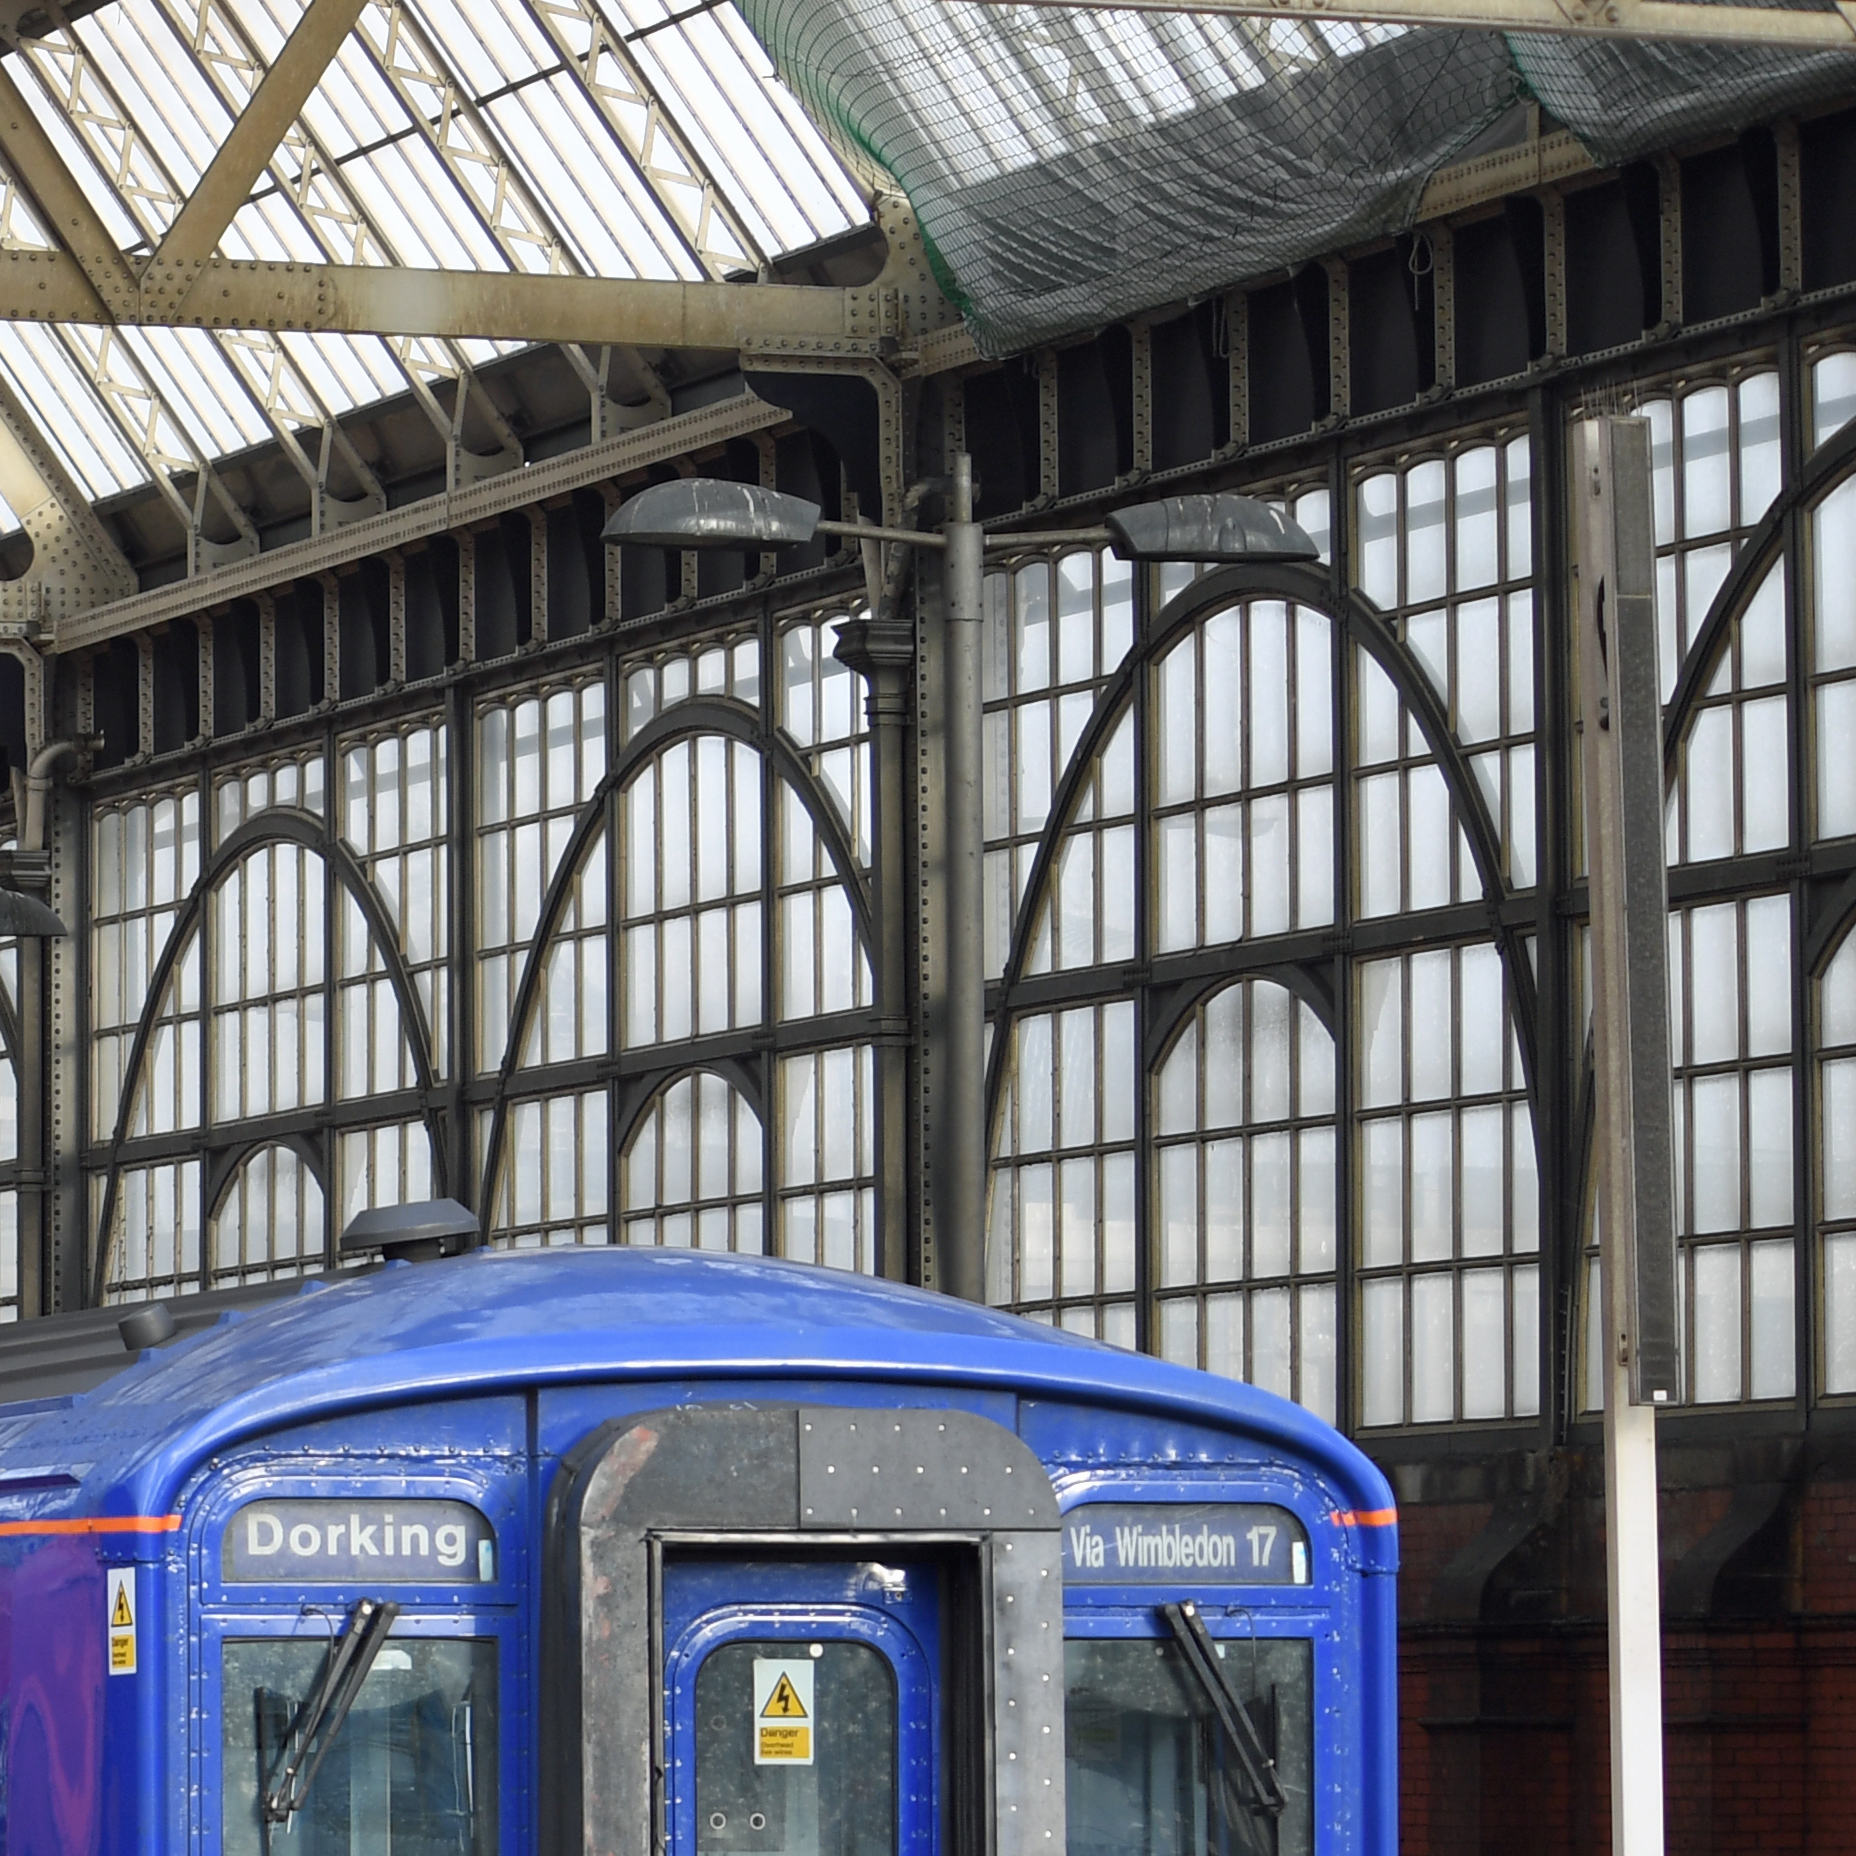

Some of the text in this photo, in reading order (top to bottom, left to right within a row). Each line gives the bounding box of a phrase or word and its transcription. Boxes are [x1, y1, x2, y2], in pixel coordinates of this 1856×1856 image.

[246, 1514, 467, 1567] Dorking
[1071, 1526, 1277, 1568] Via Wimbledon 17
[760, 1727, 799, 1739] Danger
